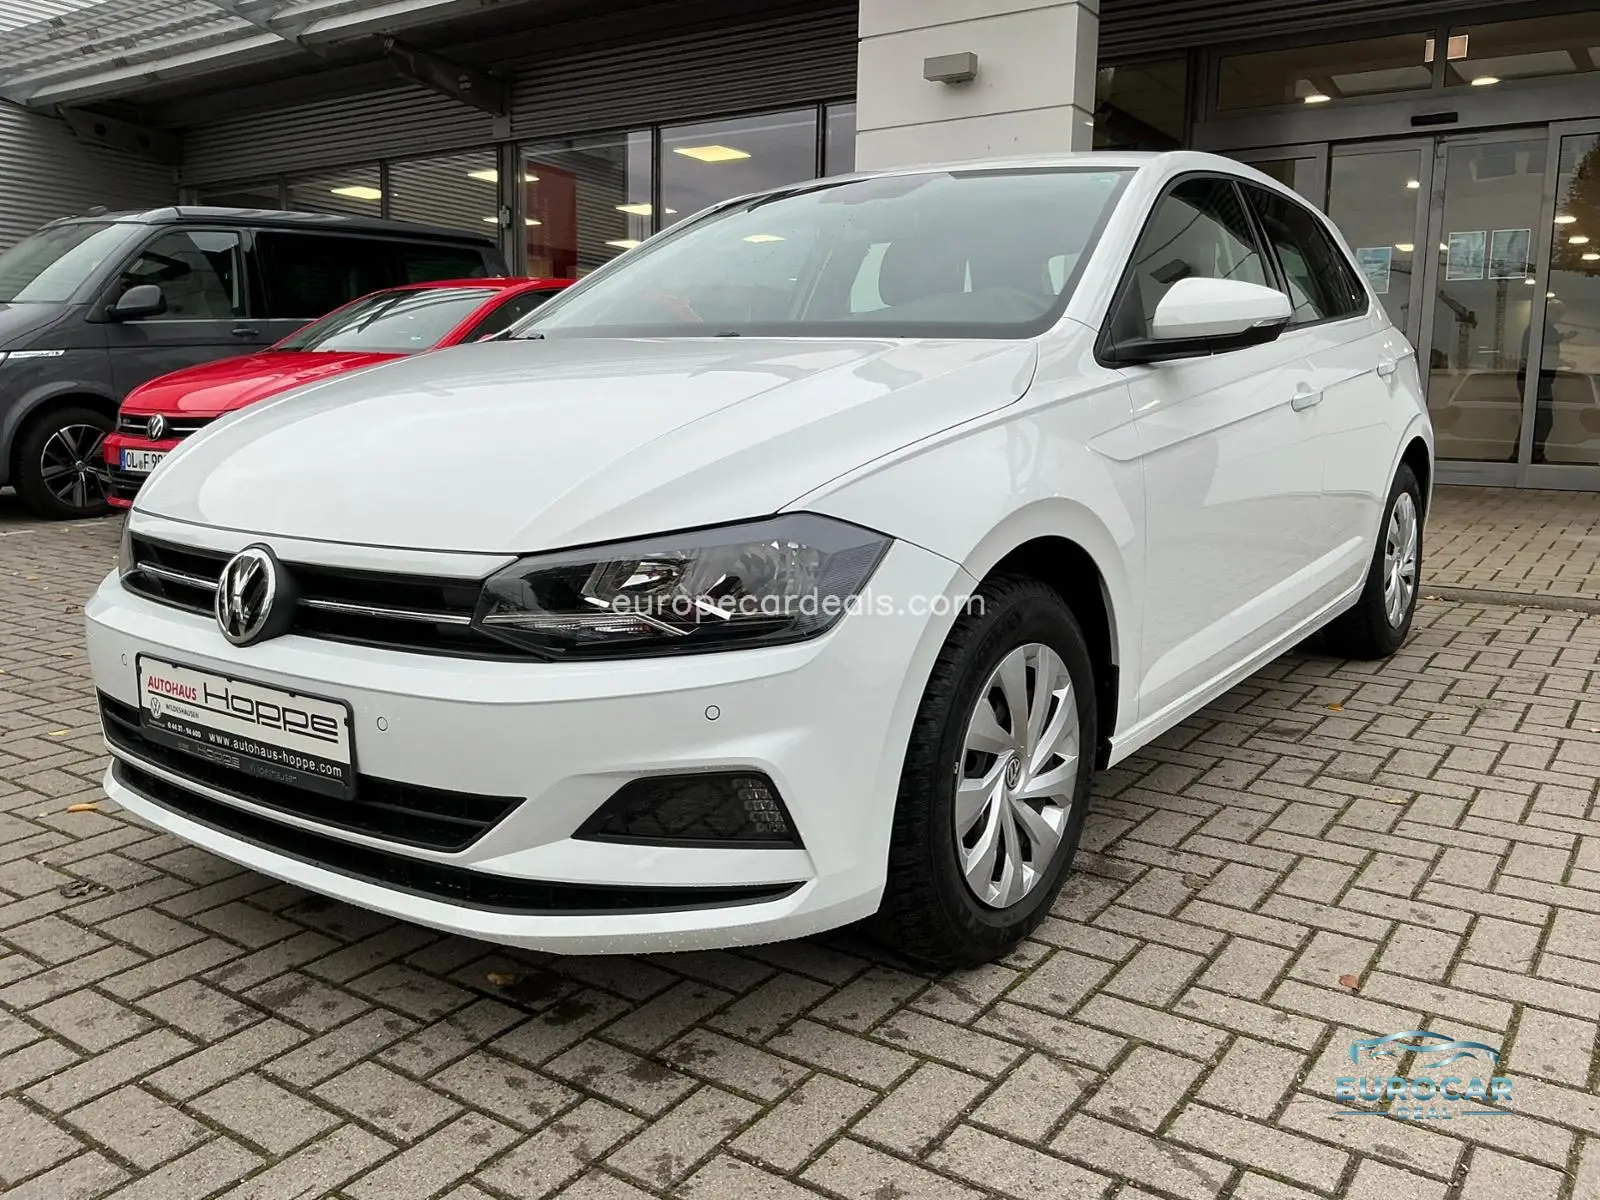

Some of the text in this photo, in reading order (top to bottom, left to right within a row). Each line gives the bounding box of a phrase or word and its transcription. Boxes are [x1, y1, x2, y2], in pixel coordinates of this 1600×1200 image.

[126, 451, 138, 468] OL
[143, 453, 150, 469] F
[147, 675, 198, 702] AUTOHAUS
[165, 703, 200, 719] WILDESHAUSEN
[208, 732, 343, 778] www.autohaus-hoppe.com
